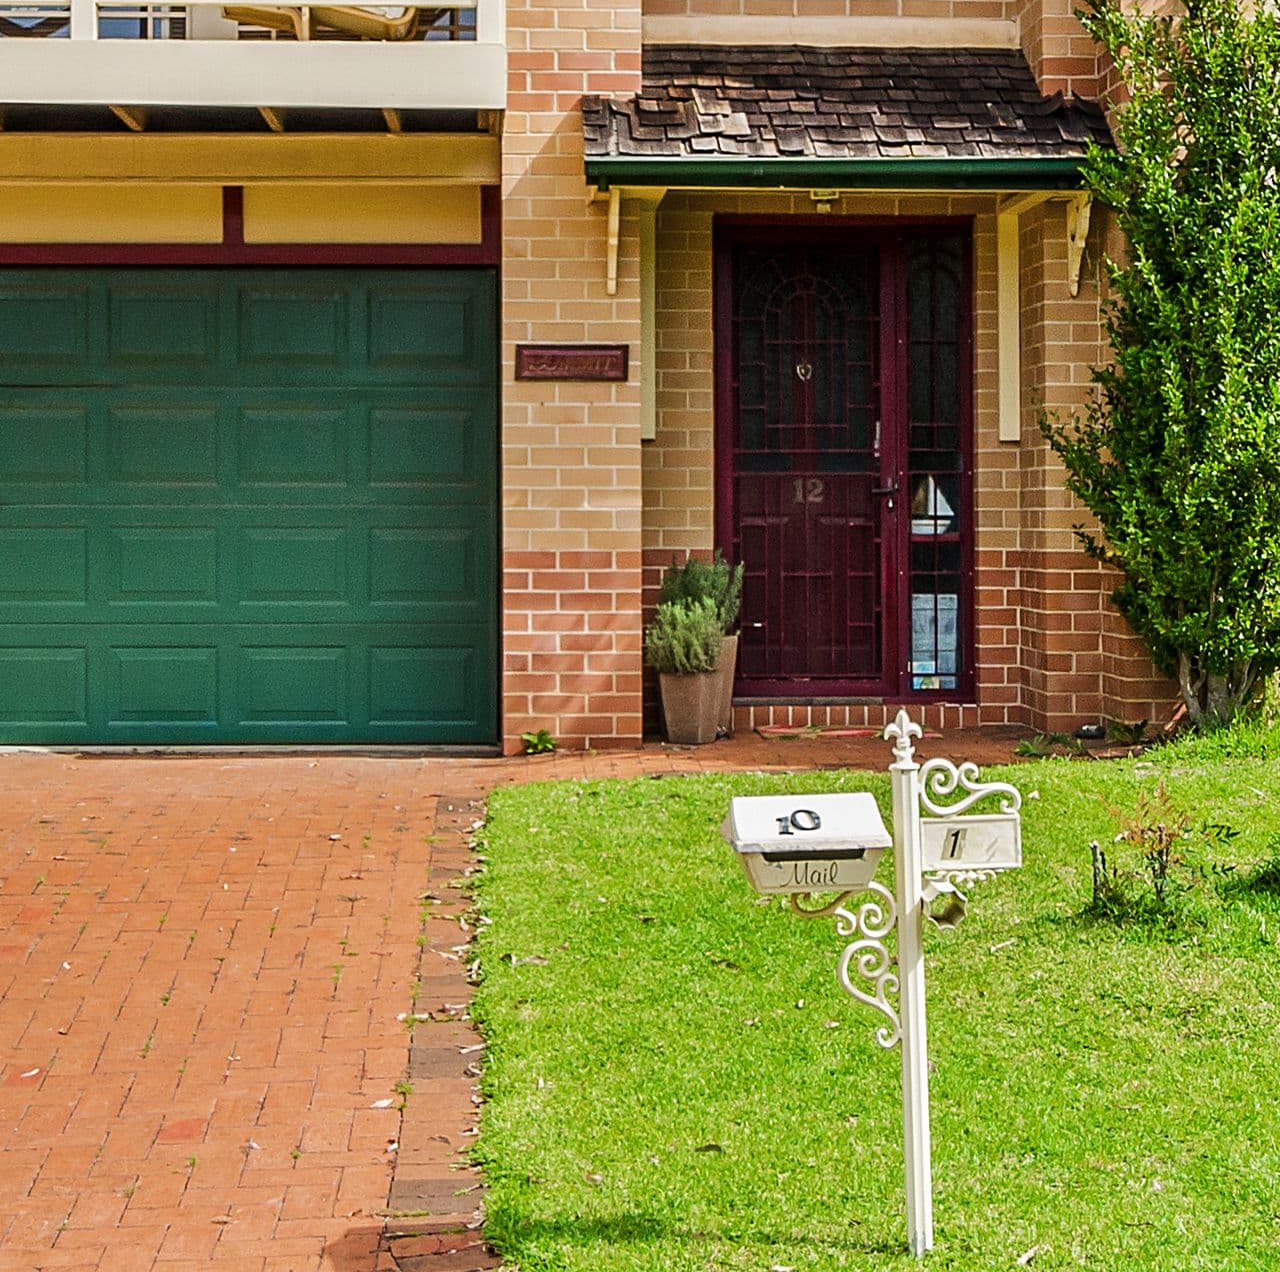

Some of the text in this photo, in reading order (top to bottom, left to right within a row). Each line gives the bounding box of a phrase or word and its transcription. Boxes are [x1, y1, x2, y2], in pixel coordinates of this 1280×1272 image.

[792, 478, 824, 504] 12
[775, 809, 821, 836] 10
[780, 861, 838, 888] Mail
